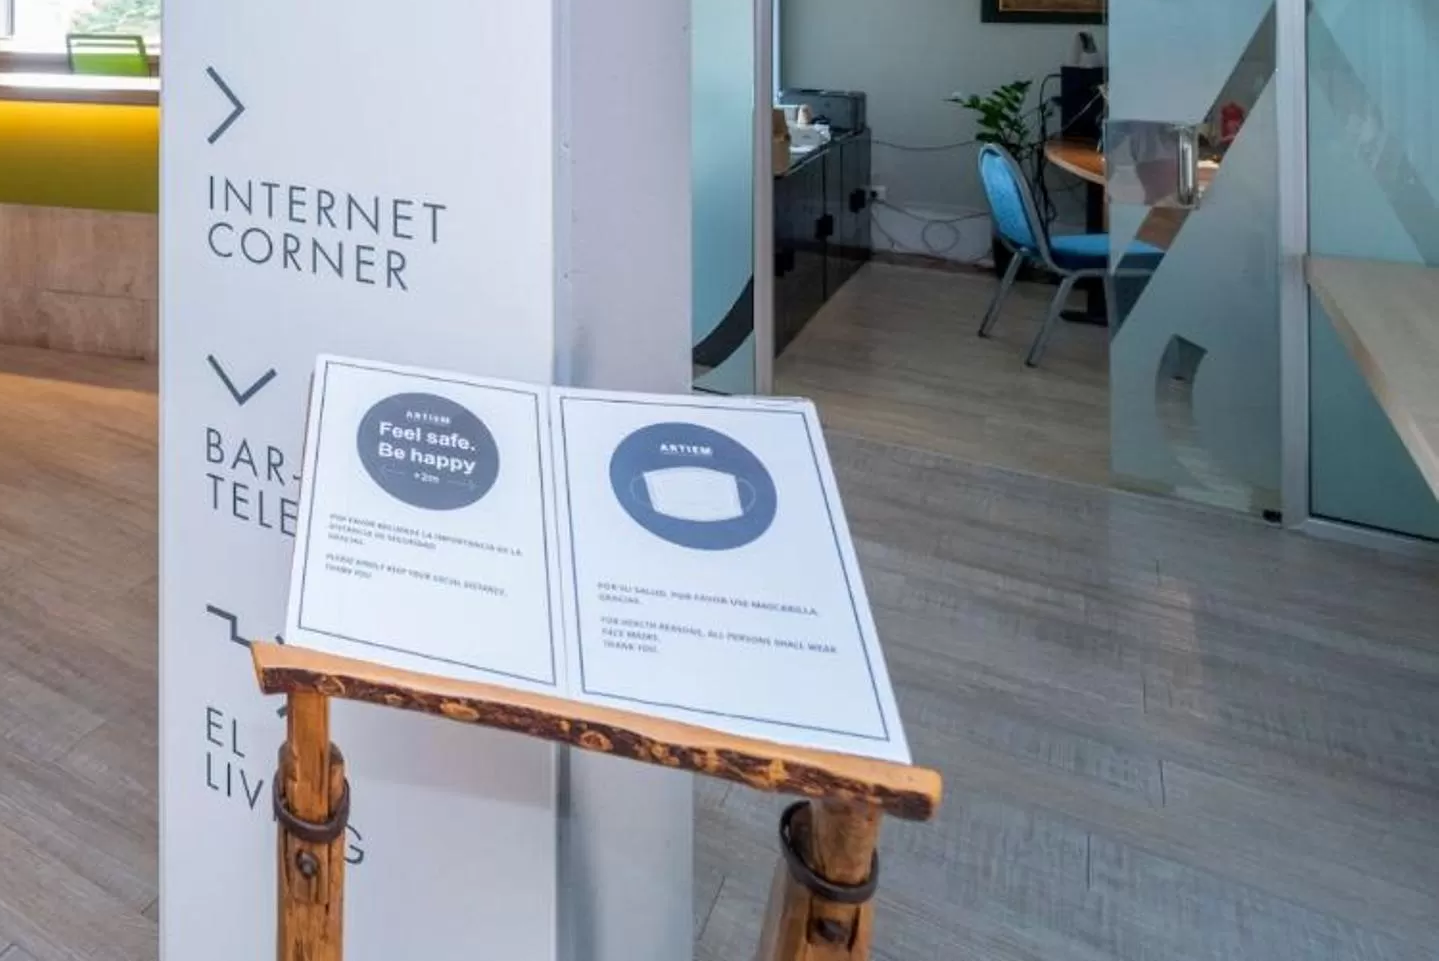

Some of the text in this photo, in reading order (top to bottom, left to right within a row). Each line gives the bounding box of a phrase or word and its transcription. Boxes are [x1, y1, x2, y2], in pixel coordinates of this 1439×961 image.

[208, 175, 448, 245] INTERNET
[207, 221, 409, 293] CORNER
[205, 426, 301, 487] BAR
[378, 420, 476, 452] Feel safe.
[378, 441, 477, 475] Be happy
[206, 707, 245, 759] EL
